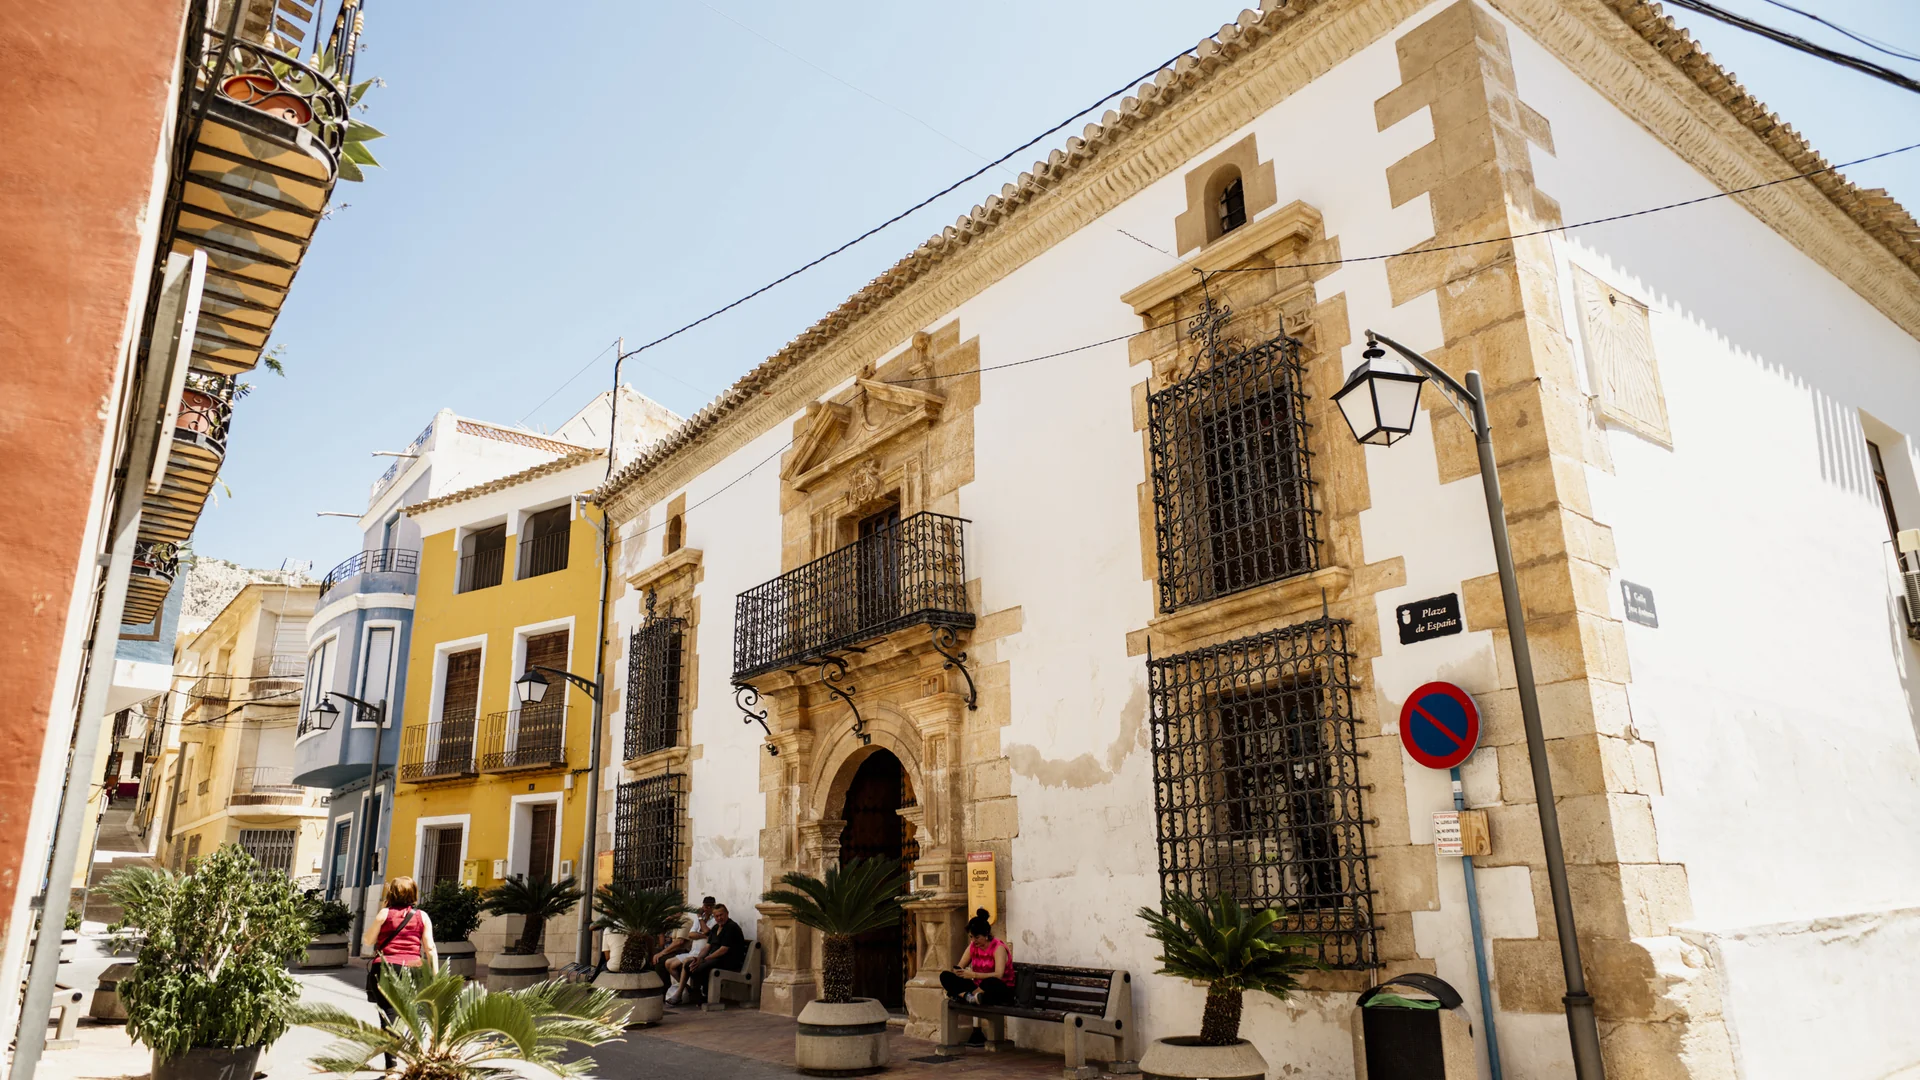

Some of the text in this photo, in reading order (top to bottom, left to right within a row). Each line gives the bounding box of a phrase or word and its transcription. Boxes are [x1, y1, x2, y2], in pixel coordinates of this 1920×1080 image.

[1422, 607, 1446, 618] Plaza
[1415, 618, 1456, 633] de España
[973, 868, 989, 876] Centro
